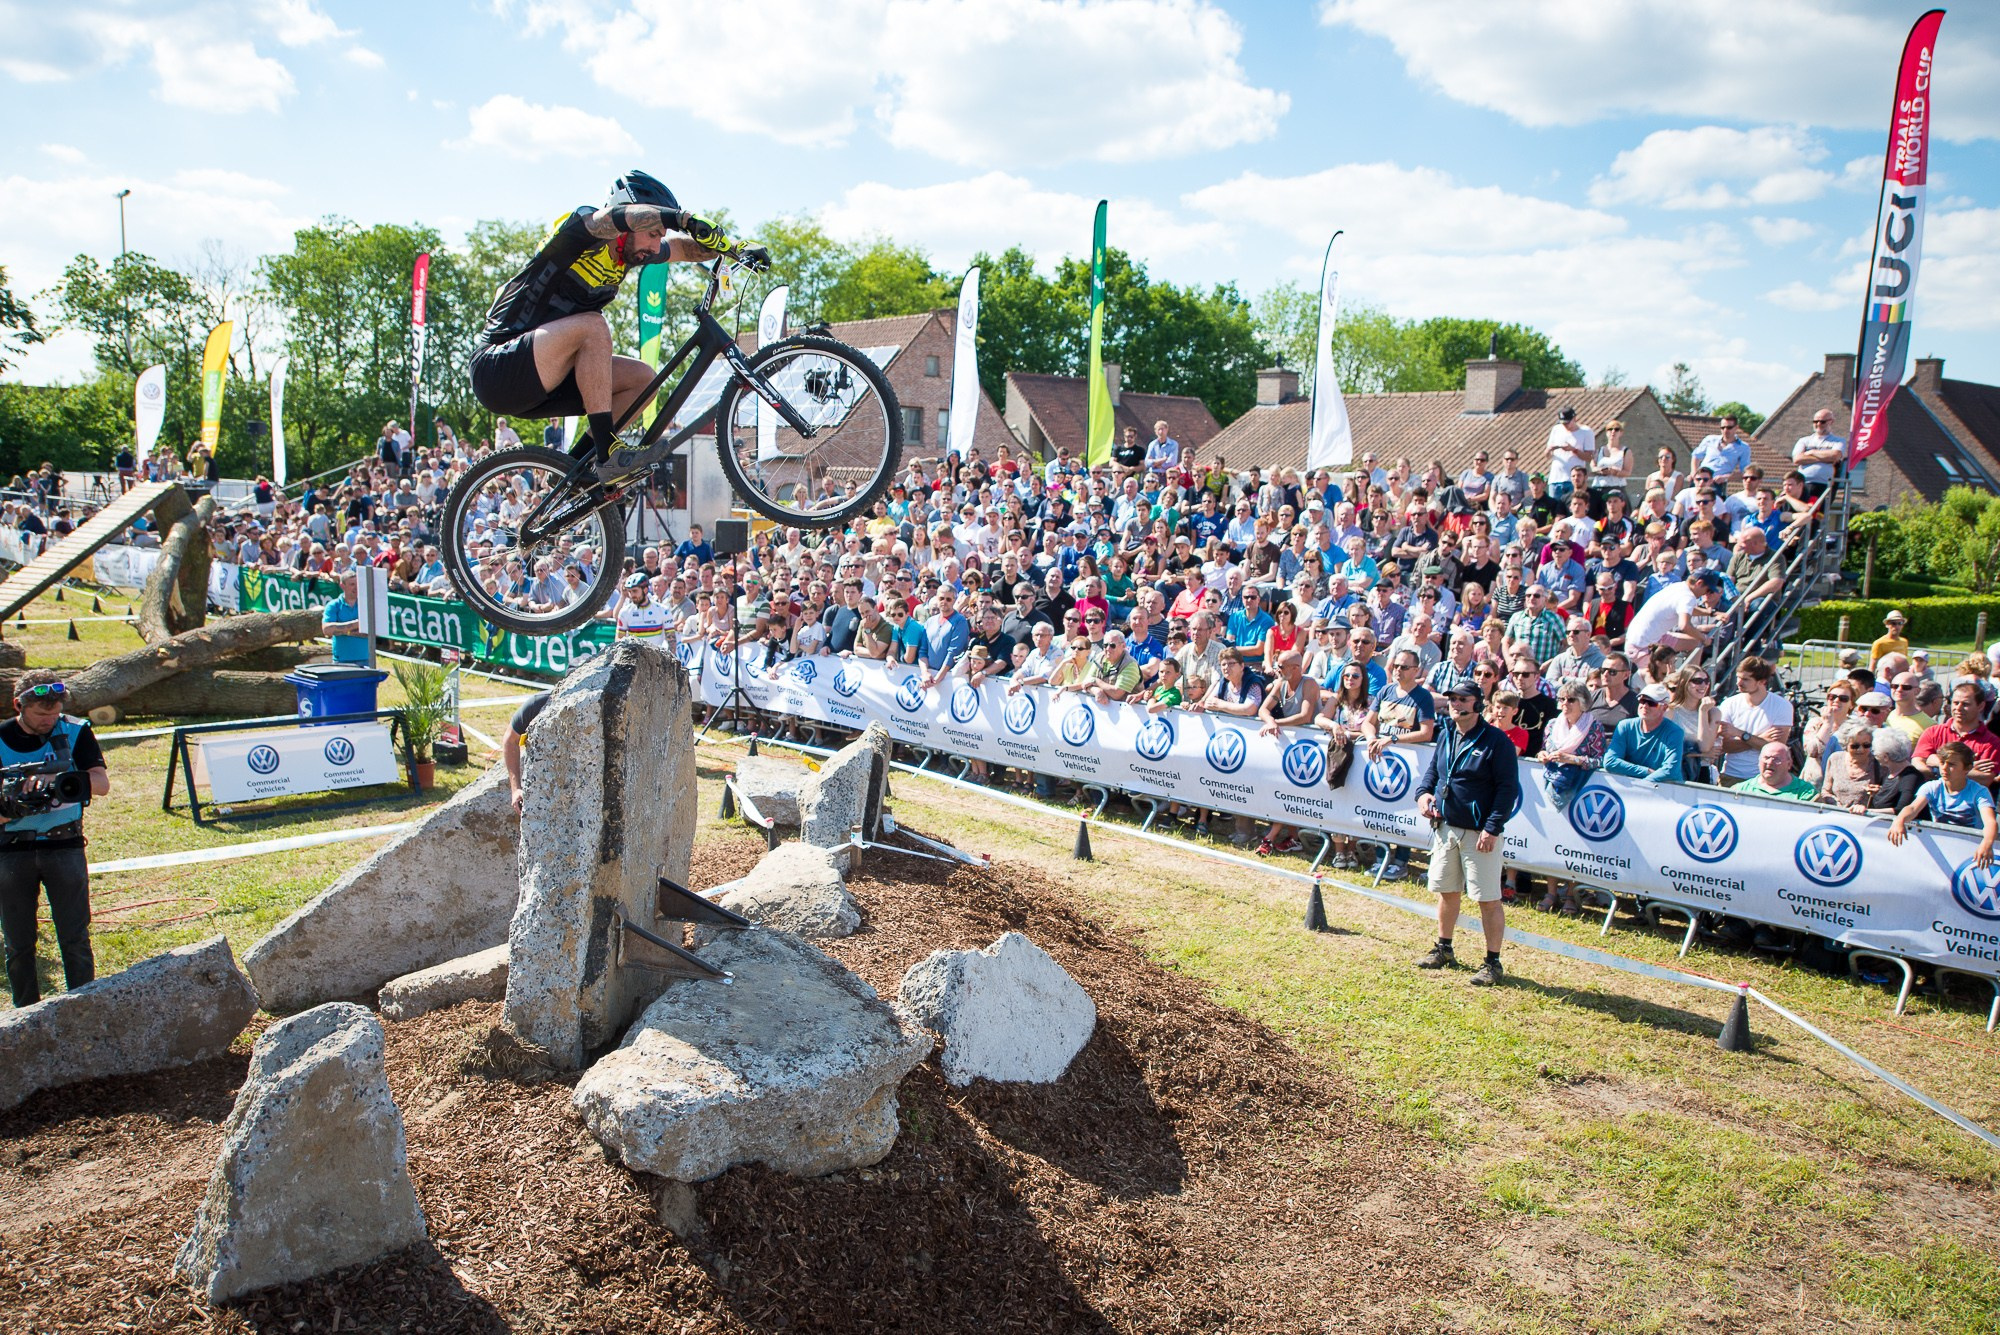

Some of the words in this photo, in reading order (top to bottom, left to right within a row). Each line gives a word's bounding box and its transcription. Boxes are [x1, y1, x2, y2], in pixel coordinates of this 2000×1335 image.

[1902, 96, 1925, 178] WORLD
[1914, 46, 1933, 92] CUP
[1894, 99, 1913, 171] TRIALS
[1874, 193, 1917, 299] UCI
[411, 329, 421, 373] UCI
[557, 497, 592, 520] TRIALTECH
[389, 599, 463, 645] relan
[509, 631, 605, 672] Crela
[830, 706, 862, 720] Vehicles
[942, 726, 984, 742] Commercial
[1390, 727, 1411, 736] ROAD
[950, 736, 979, 750] Vehicles
[997, 737, 1040, 754] Commercial
[1004, 748, 1036, 762] Vehicles
[1054, 749, 1101, 765] Commercial
[323, 768, 365, 778] Commercial
[1062, 760, 1096, 774] Vehicles
[1129, 763, 1182, 781] Commercial
[246, 777, 291, 787] Commercial
[255, 784, 286, 794] Vehicles
[331, 776, 360, 785] Vehicles
[1139, 775, 1175, 789] Vehicles
[1199, 776, 1255, 795] Commercial
[1208, 789, 1247, 804] Vehicles
[1274, 790, 1333, 810] Commercial
[1283, 803, 1324, 820] Vehicles
[1354, 805, 1417, 827] Commercial
[1363, 819, 1407, 838] Vehicles
[1503, 836, 1528, 849] rcial
[1554, 844, 1632, 870] Commercial
[1564, 861, 1618, 881] Vehicles
[1660, 865, 1745, 891] Commercial
[1672, 881, 1732, 902] Vehicles
[1777, 888, 1871, 916] Commercial
[1791, 904, 1854, 929] Vehicles
[1932, 920, 2000, 945] Comme
[1945, 939, 2000, 962] Vehicl
